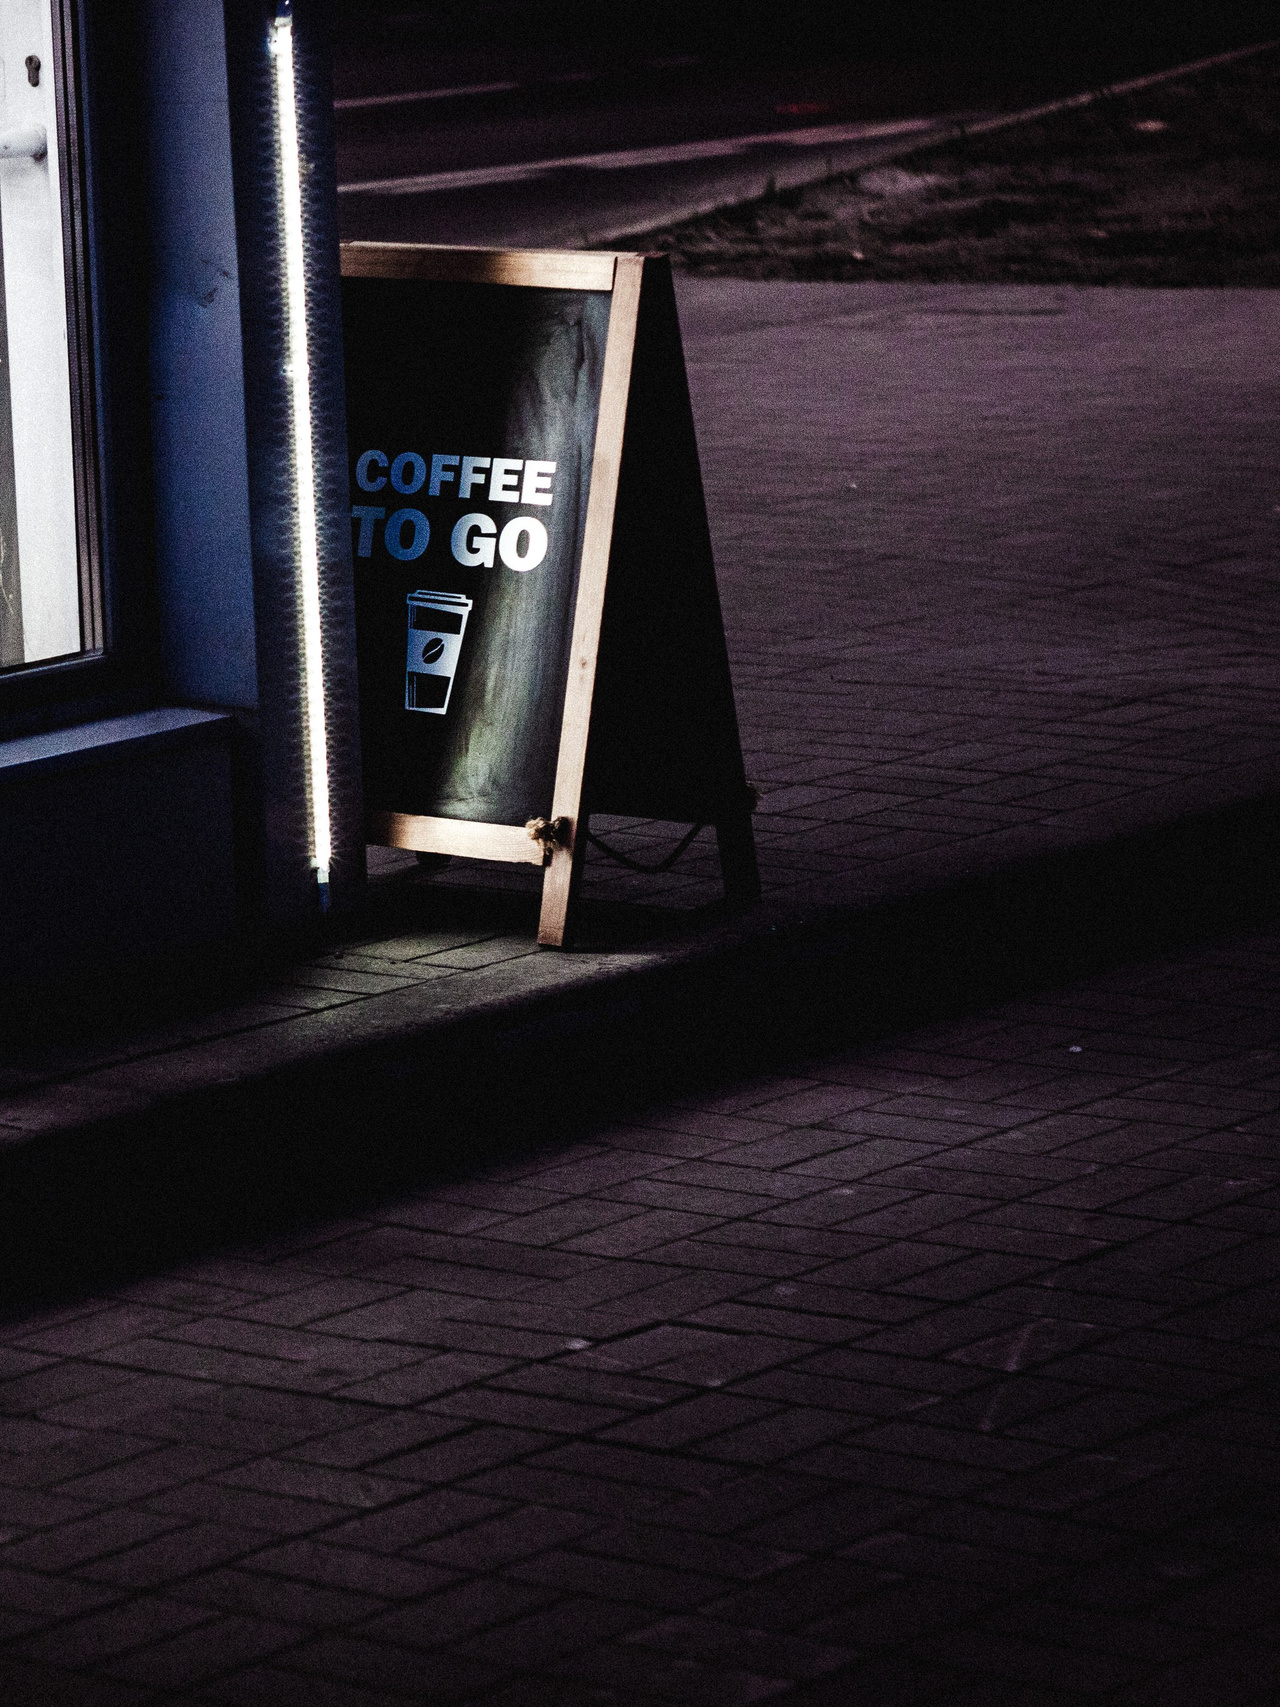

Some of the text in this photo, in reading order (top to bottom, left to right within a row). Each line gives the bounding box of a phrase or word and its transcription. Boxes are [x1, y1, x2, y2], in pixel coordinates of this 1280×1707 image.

[355, 449, 557, 506] COFFEE
[351, 504, 548, 572] TO GO
